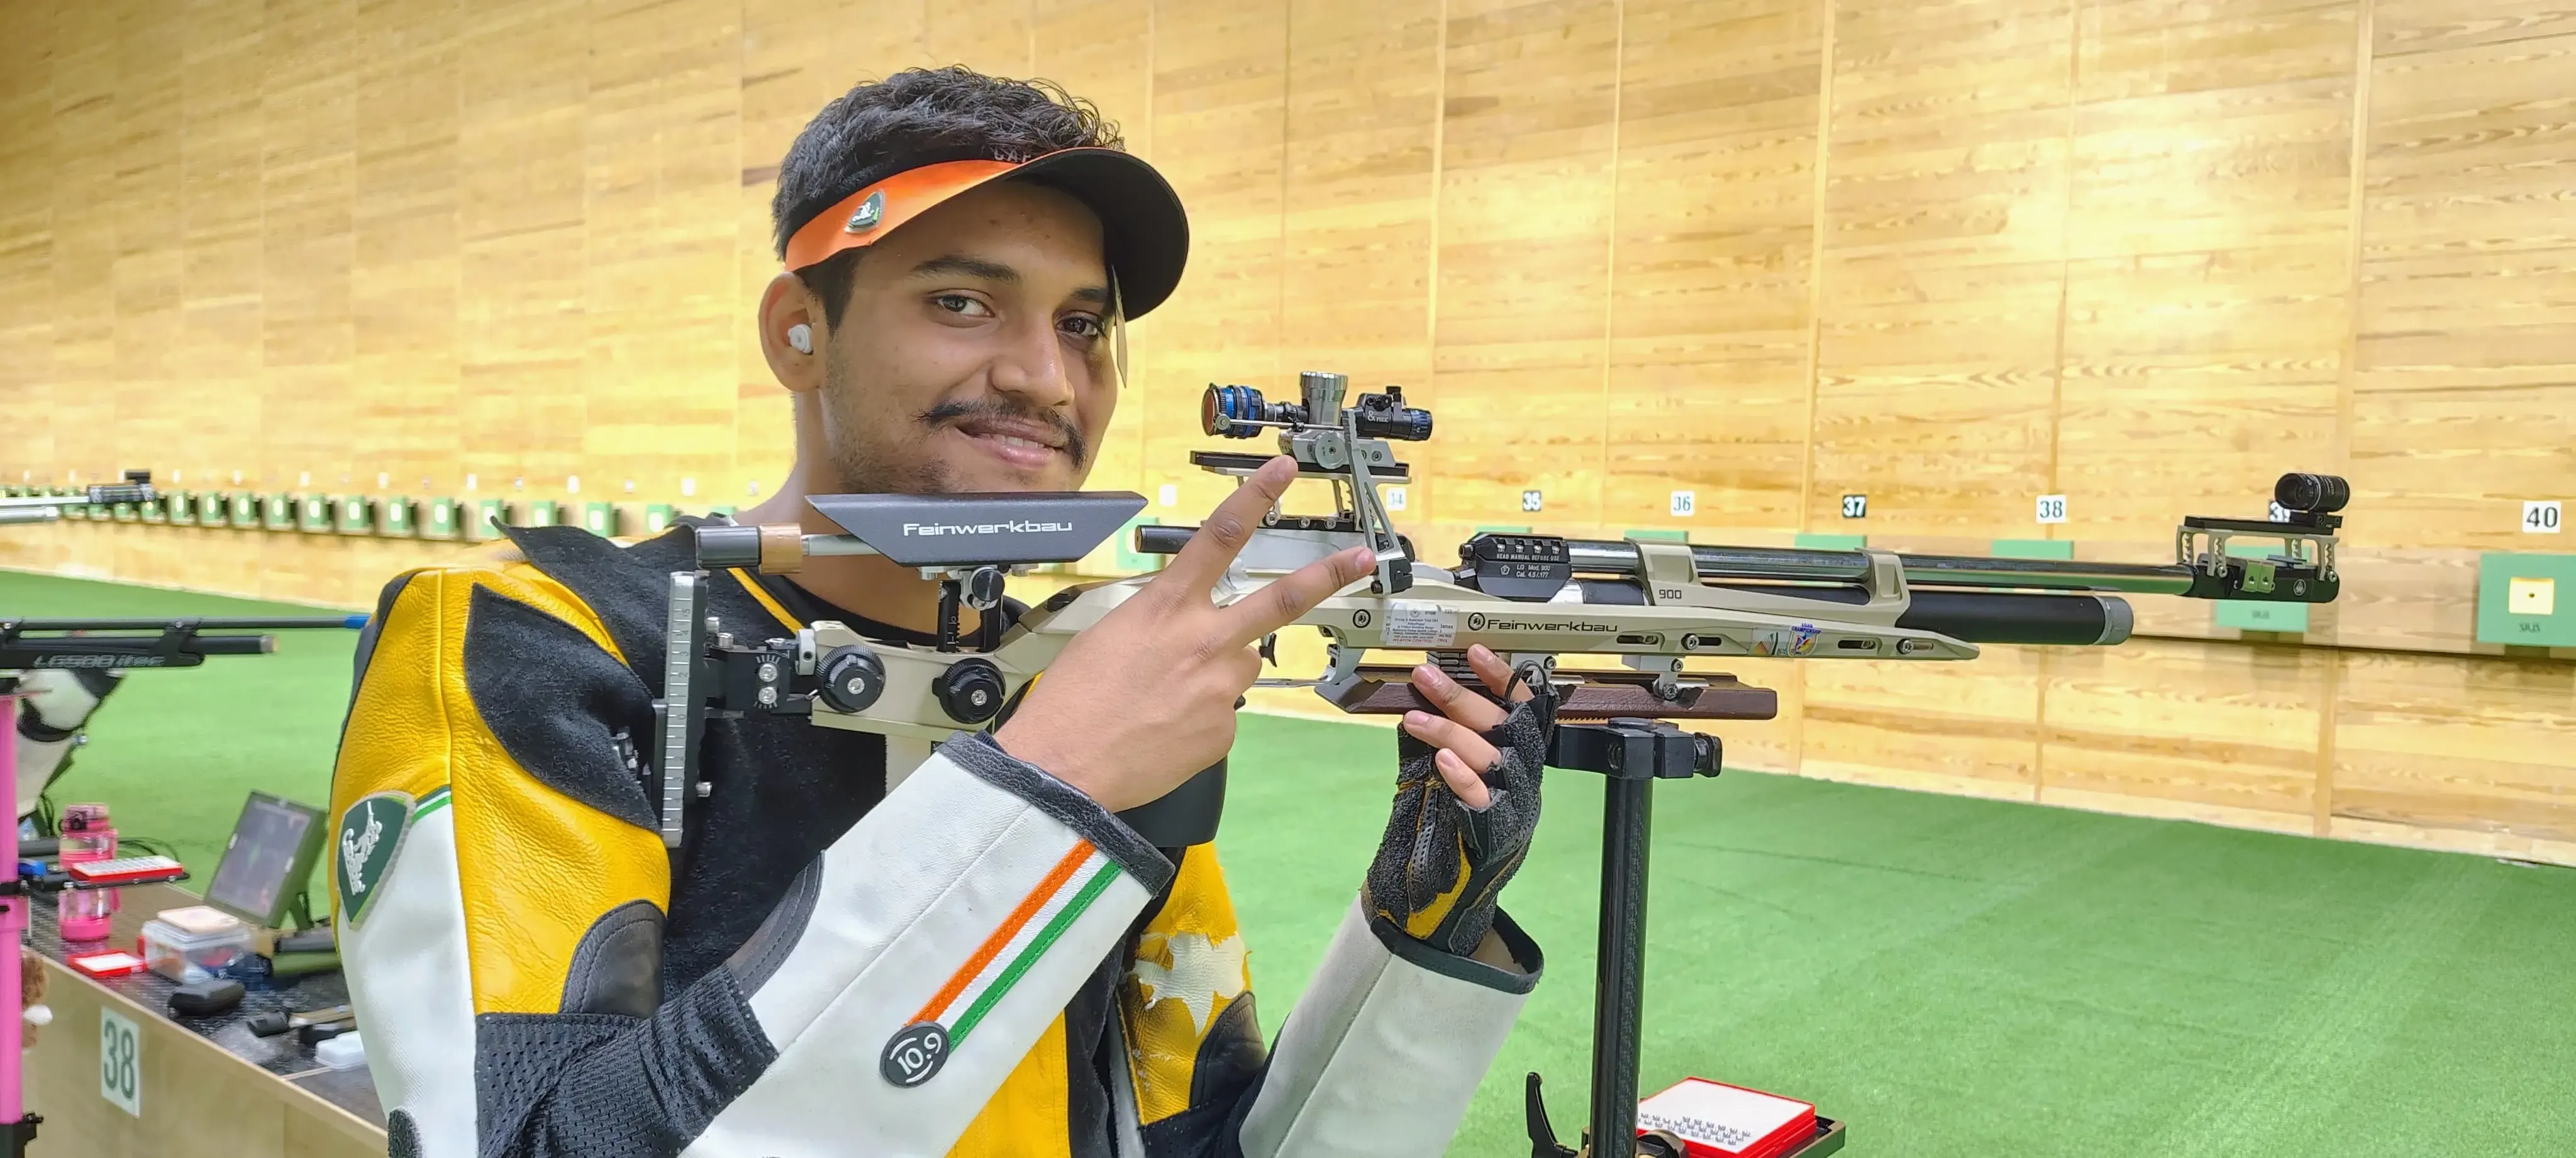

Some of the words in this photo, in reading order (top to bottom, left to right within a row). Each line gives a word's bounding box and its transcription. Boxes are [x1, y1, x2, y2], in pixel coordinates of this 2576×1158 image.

[1523, 492, 1541, 511] 35
[1674, 495, 1691, 511] 36
[1843, 495, 1866, 517] 37
[2040, 500, 2063, 519] 38
[2526, 507, 2558, 529] 40
[903, 520, 1072, 536] Feinwerkbau
[1659, 589, 1682, 599] 900
[1487, 619, 1618, 632] Feinwerkbau
[104, 1018, 135, 1100] 38
[897, 1032, 941, 1075] 10.9
